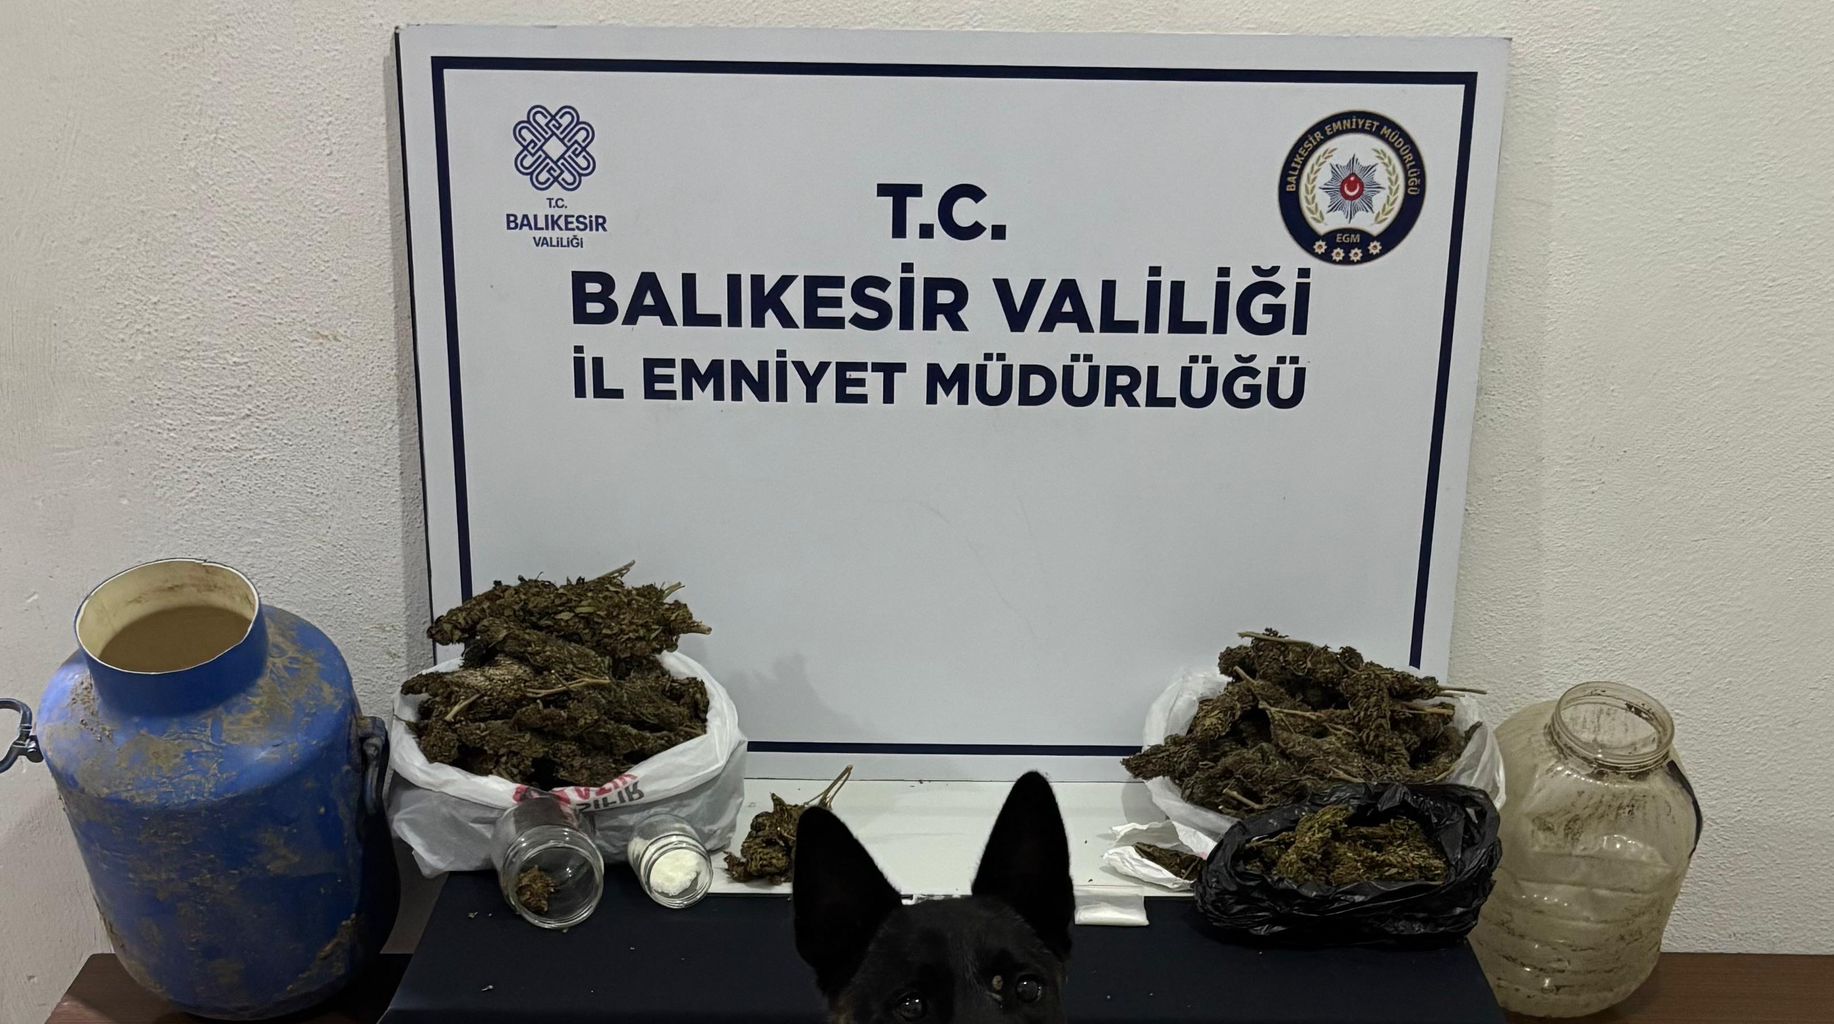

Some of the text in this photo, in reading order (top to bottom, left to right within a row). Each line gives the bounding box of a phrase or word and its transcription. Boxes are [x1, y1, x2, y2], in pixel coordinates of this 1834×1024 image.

[1286, 116, 1420, 195] BALIKESİR EMNİYET MÜDÜRLÜĞÜ
[506, 213, 608, 232] BALIKESİR
[546, 197, 568, 209] T.C.
[877, 182, 1008, 241] T.C.
[1336, 233, 1361, 243] EGM
[571, 263, 1310, 336] BALIKESİR VALİLİĞİ
[574, 345, 1307, 410] İL EMNİYET MÜDÜRLÜĞÜ
